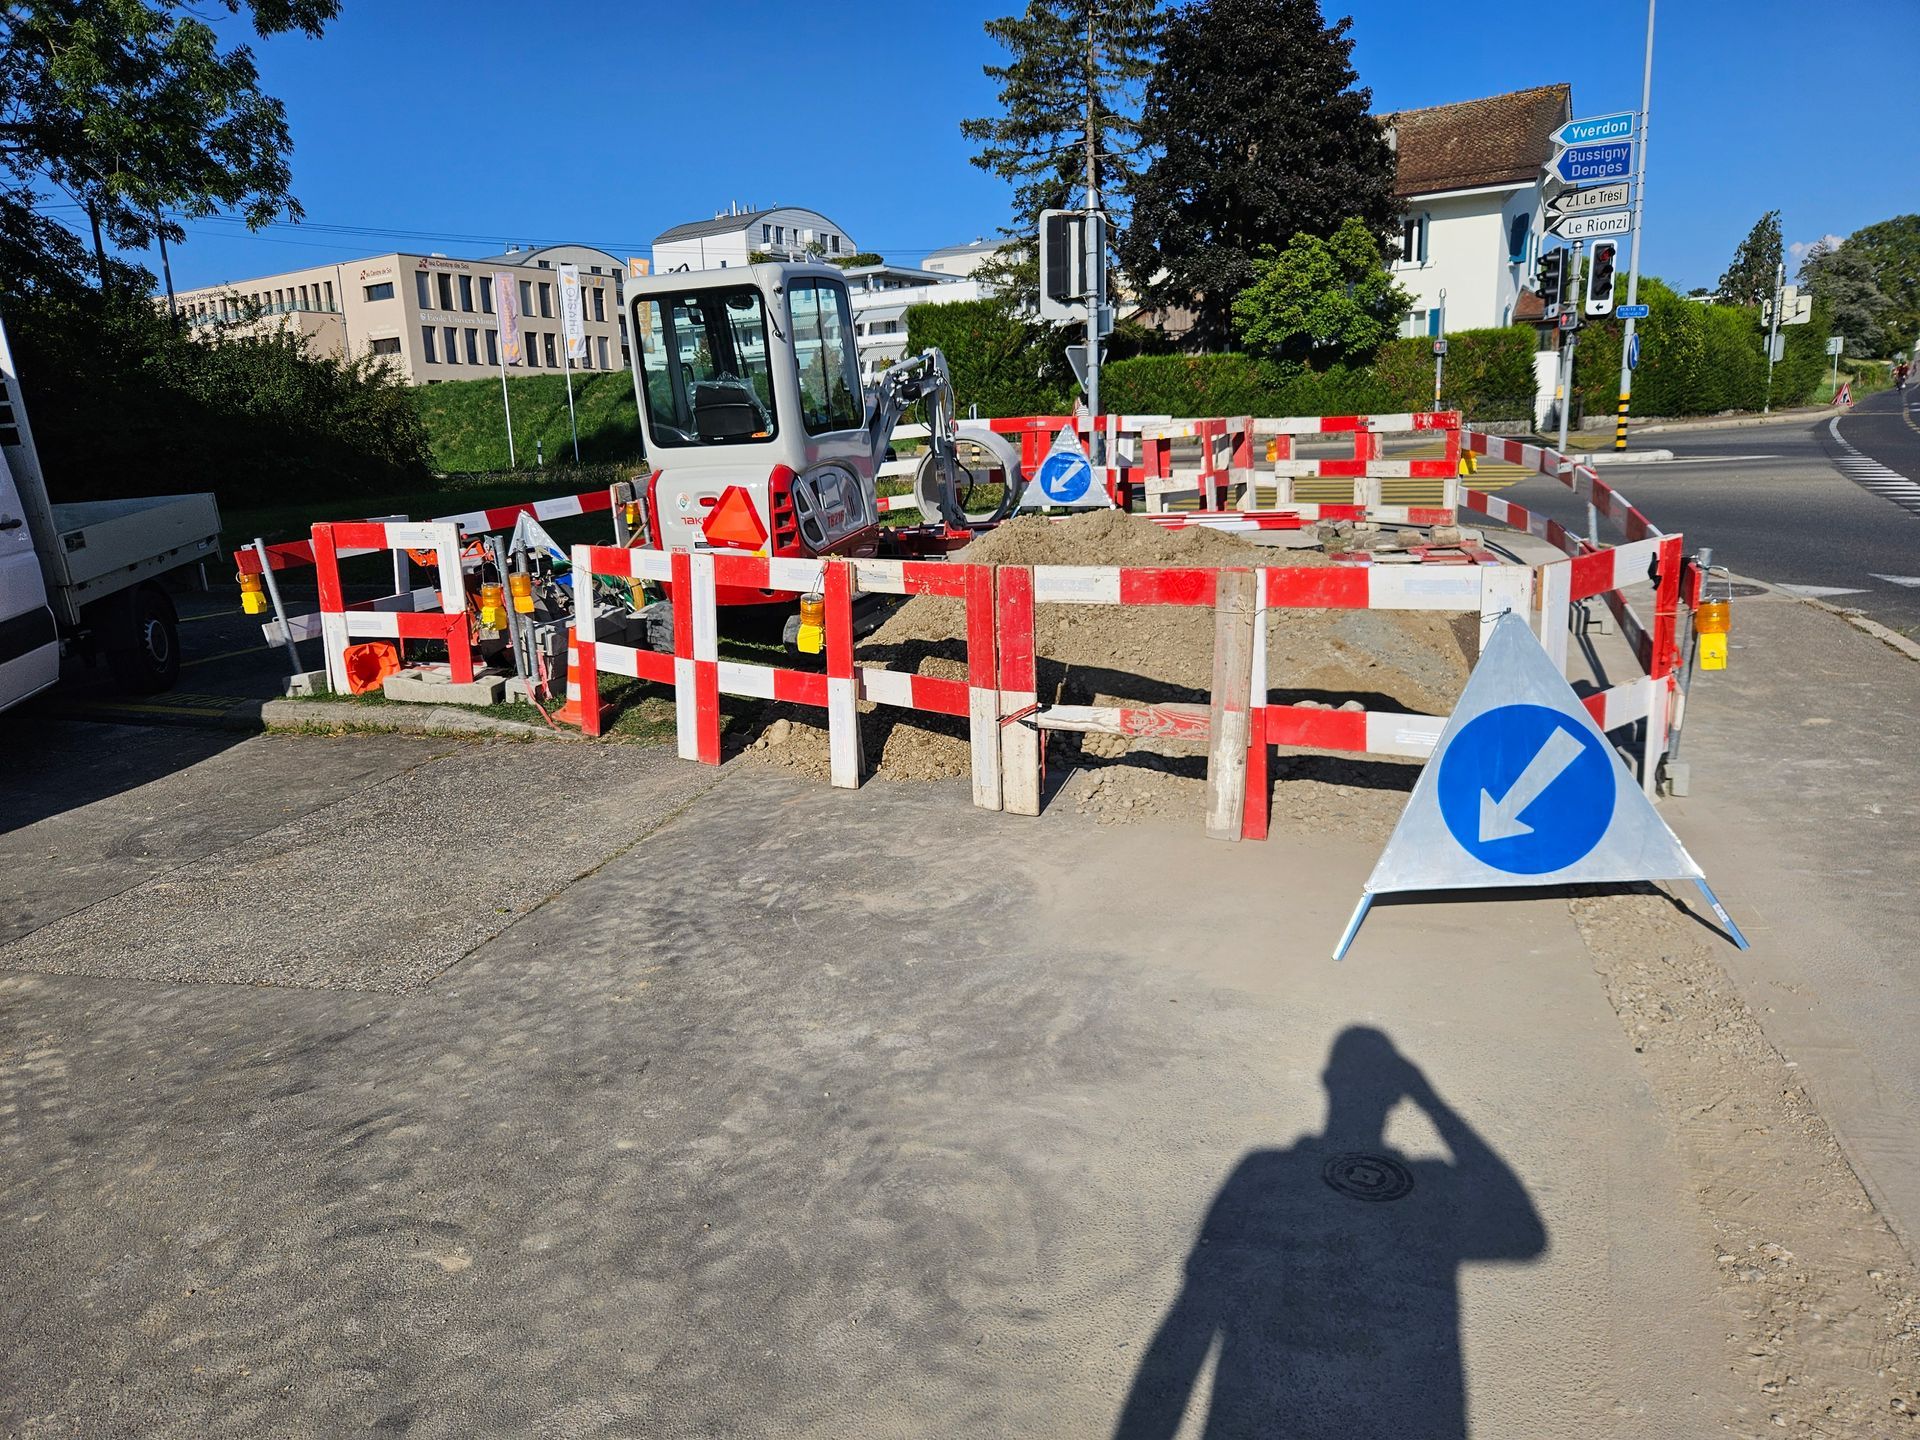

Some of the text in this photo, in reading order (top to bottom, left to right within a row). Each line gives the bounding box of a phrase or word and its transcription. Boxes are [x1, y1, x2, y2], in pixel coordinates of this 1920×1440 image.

[1572, 121, 1628, 139] Yverdon
[1568, 147, 1629, 163] Bussigny
[1571, 162, 1623, 177] Denges
[1566, 196, 1581, 208] Z.I.
[1584, 194, 1596, 205] Le
[1568, 215, 1627, 235] Le Rionzi
[435, 260, 454, 268] Centre
[580, 276, 595, 285] SIO
[566, 287, 578, 335] PHYSIO
[448, 315, 475, 324] Univers
[827, 510, 844, 528] TB216
